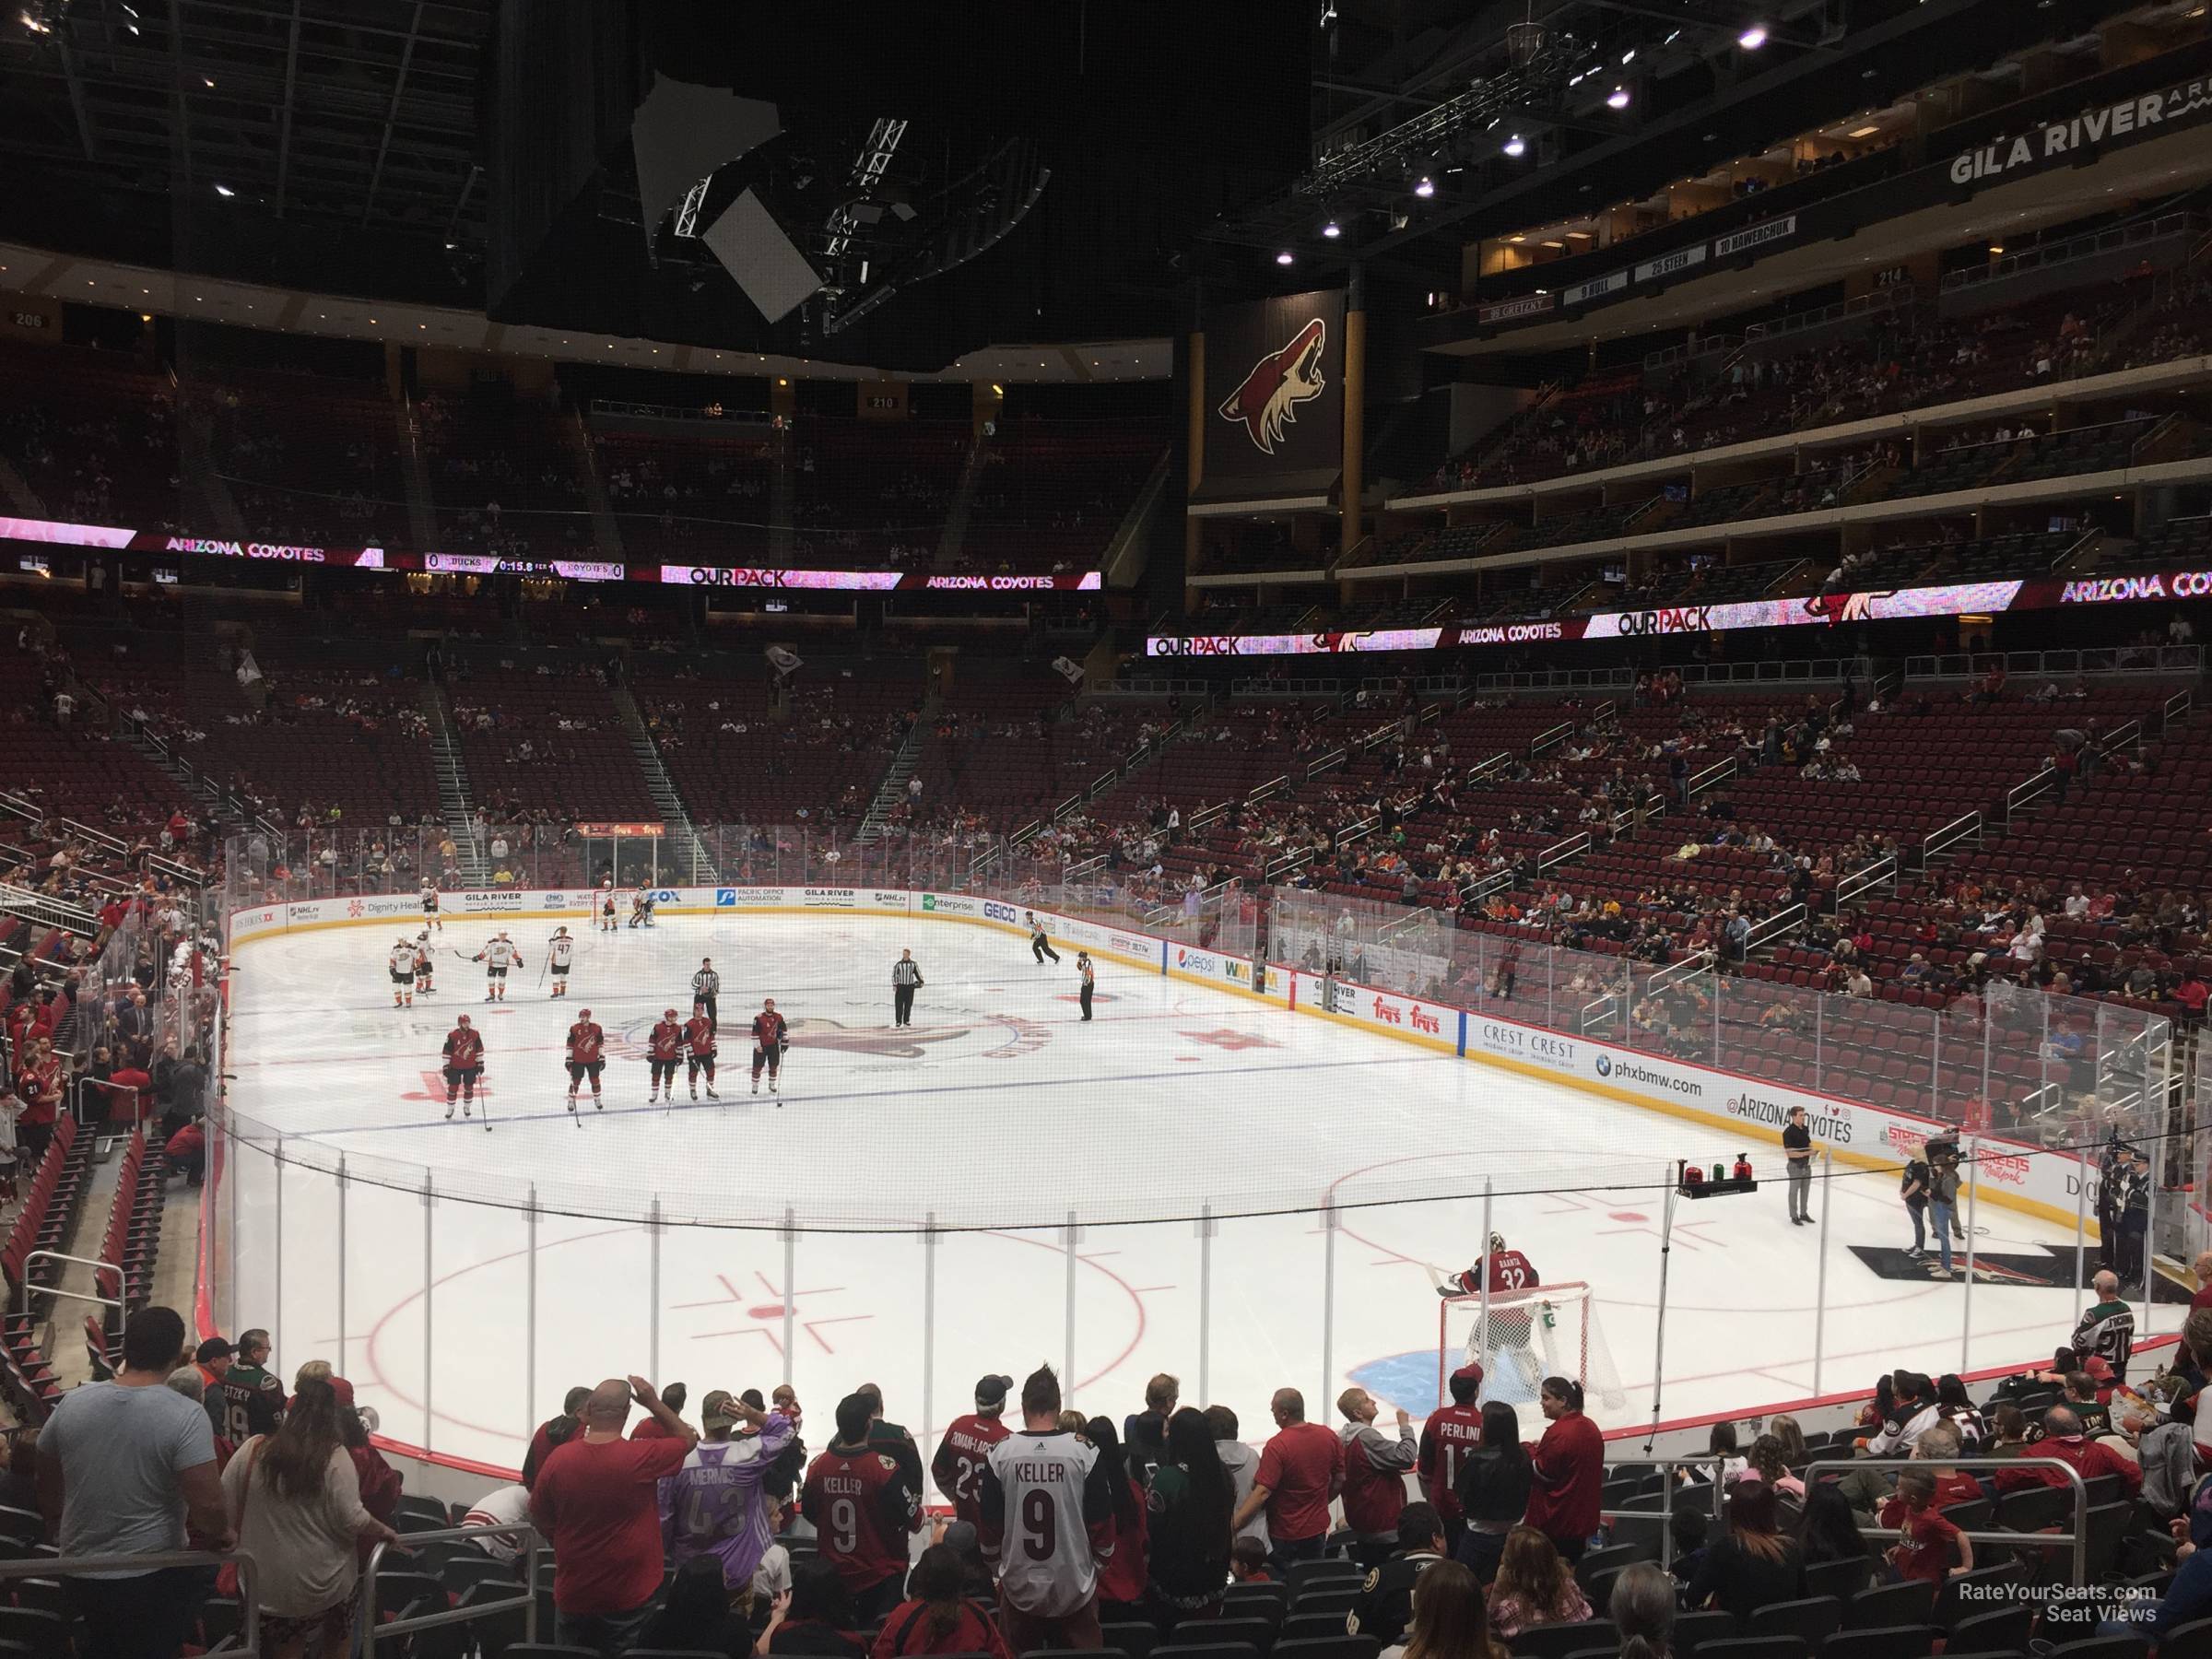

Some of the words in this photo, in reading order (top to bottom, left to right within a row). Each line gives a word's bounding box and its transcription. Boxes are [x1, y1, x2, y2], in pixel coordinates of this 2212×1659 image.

[1950, 135, 2032, 184] GILA
[2044, 94, 2163, 157] RIVER
[2168, 76, 2212, 105] AR
[1720, 241, 1730, 254] 10
[1732, 218, 1790, 253] HAWERCHUK
[1651, 260, 1663, 276] 25
[1664, 253, 1688, 274] STEEN
[1581, 286, 1588, 300] 9
[1589, 278, 1609, 296] HULL
[166, 536, 243, 557] ARIZONA
[248, 543, 325, 562] COYOTES
[429, 554, 438, 567] 0
[452, 558, 481, 566] DUCKS
[613, 564, 622, 578] 0
[926, 575, 988, 590] ARIZONA
[991, 575, 1053, 590] COYOTES
[2059, 573, 2166, 603] ARIZONA
[1458, 625, 1504, 644] ARIZONA
[1508, 621, 1561, 641] COYOTES
[368, 901, 399, 913] Dignity
[400, 900, 426, 910] Healt
[465, 893, 488, 901] GILA
[490, 892, 522, 900] RIVER
[984, 902, 1016, 923] GEICO
[558, 944, 571, 955] 47
[1187, 954, 1215, 972] pepsi
[1225, 959, 1250, 982] WM
[1372, 995, 1401, 1024] fry's
[1410, 1004, 1440, 1034] fry's
[1484, 1024, 1524, 1046] CREST
[1531, 1036, 1574, 1059] CREST
[1615, 1061, 1702, 1097] phxbmw.com
[1500, 1268, 1525, 1290] 32
[1441, 1422, 1480, 1441] PERLINI
[689, 1467, 735, 1486] MERMIS
[1015, 1463, 1065, 1482] KELLER
[824, 1477, 863, 1495] KELLER
[688, 1487, 746, 1535] 43
[831, 1499, 856, 1553] 9
[1022, 1488, 1056, 1561] 9
